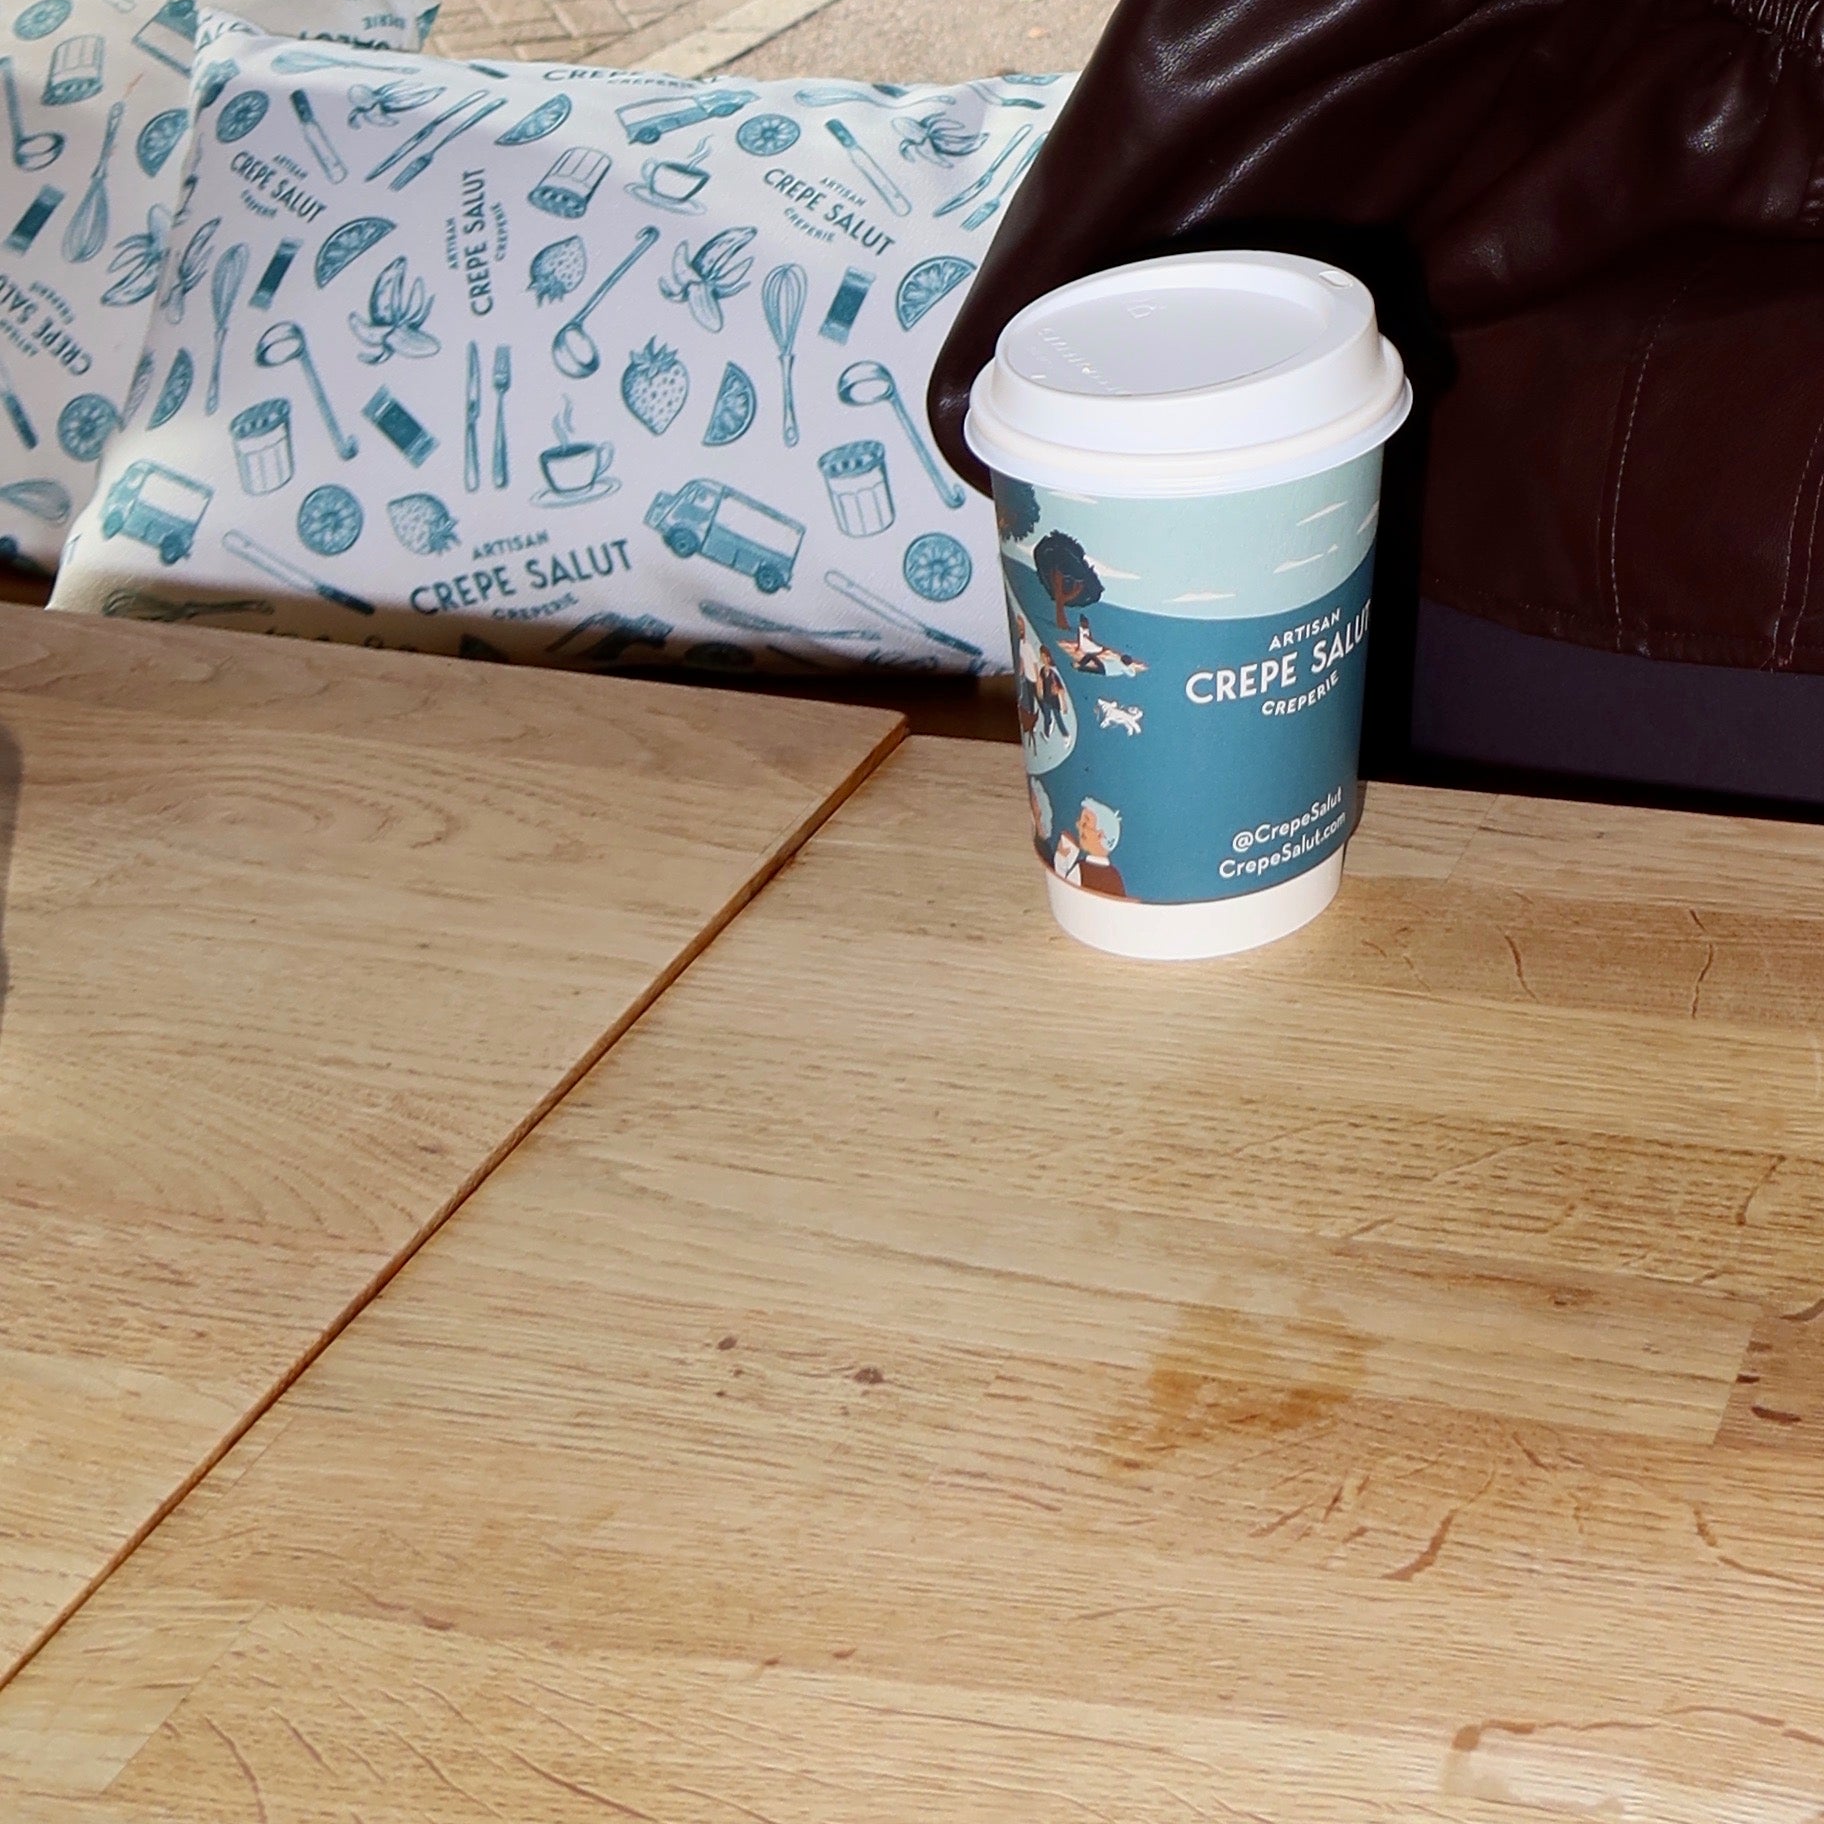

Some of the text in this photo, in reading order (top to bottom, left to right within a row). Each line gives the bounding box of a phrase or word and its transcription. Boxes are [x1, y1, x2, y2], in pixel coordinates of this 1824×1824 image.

[230, 151, 327, 224] CREPE SALUT
[763, 168, 896, 256] CREPE SALUT
[820, 177, 866, 206] ARTISAN
[446, 217, 458, 269] ARTISAN
[462, 168, 494, 316] CREPE SALUT
[490, 202, 508, 262] CREPERIE
[784, 208, 835, 242] CREPERIE
[32, 316, 93, 376] CREPE
[473, 530, 550, 560] ARTISAN
[409, 538, 632, 615] CREPE SALUT
[493, 592, 579, 620] CREPERIE
[1186, 598, 1371, 705] CREPE SALUT
[1268, 607, 1341, 652] ARTISAN
[1261, 670, 1340, 716] CREPERIE
[1219, 812, 1346, 879] CrepeSalut.com
[1232, 786, 1342, 853] @CrepeSalut
